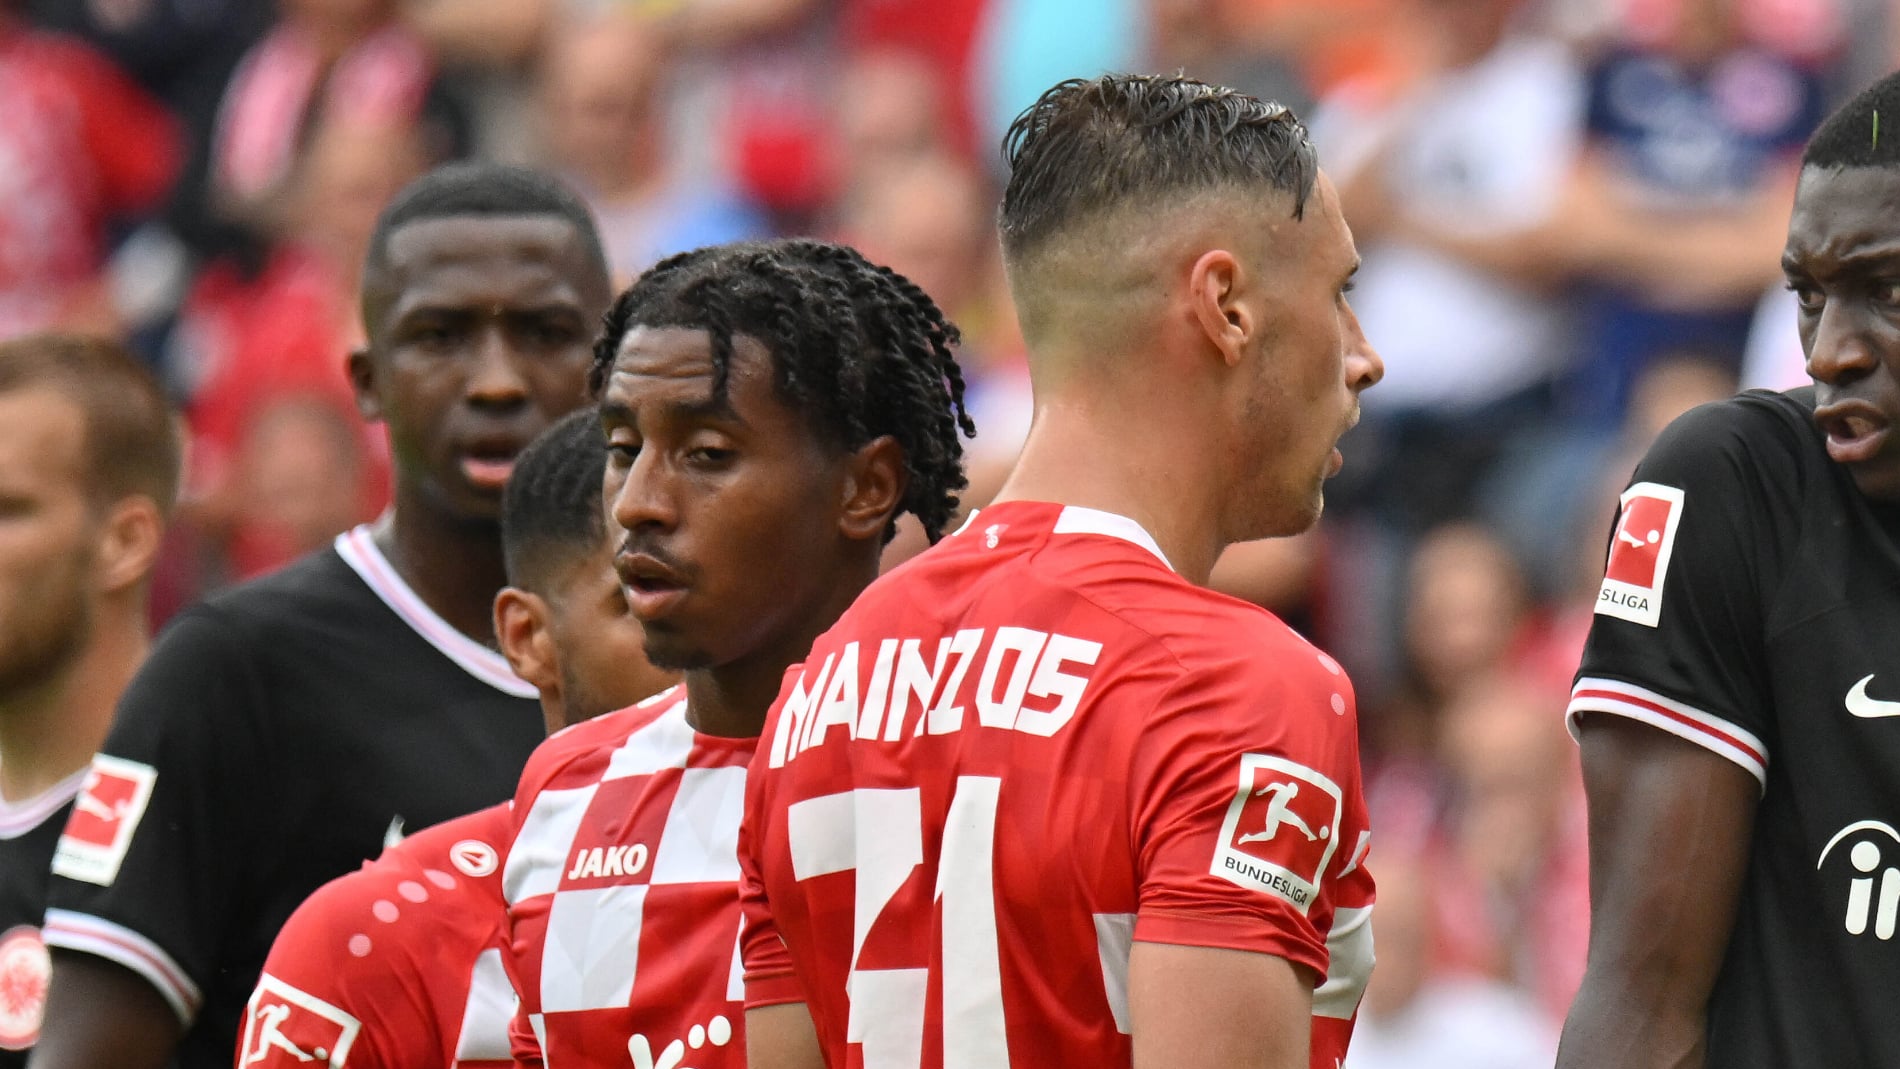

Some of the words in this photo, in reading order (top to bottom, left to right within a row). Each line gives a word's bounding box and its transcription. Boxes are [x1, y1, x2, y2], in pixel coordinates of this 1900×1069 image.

[768, 628, 985, 769] MAINZ
[975, 626, 1104, 738] 05
[568, 843, 648, 880] JAKO
[1224, 856, 1308, 906] BUNDESLIGA
